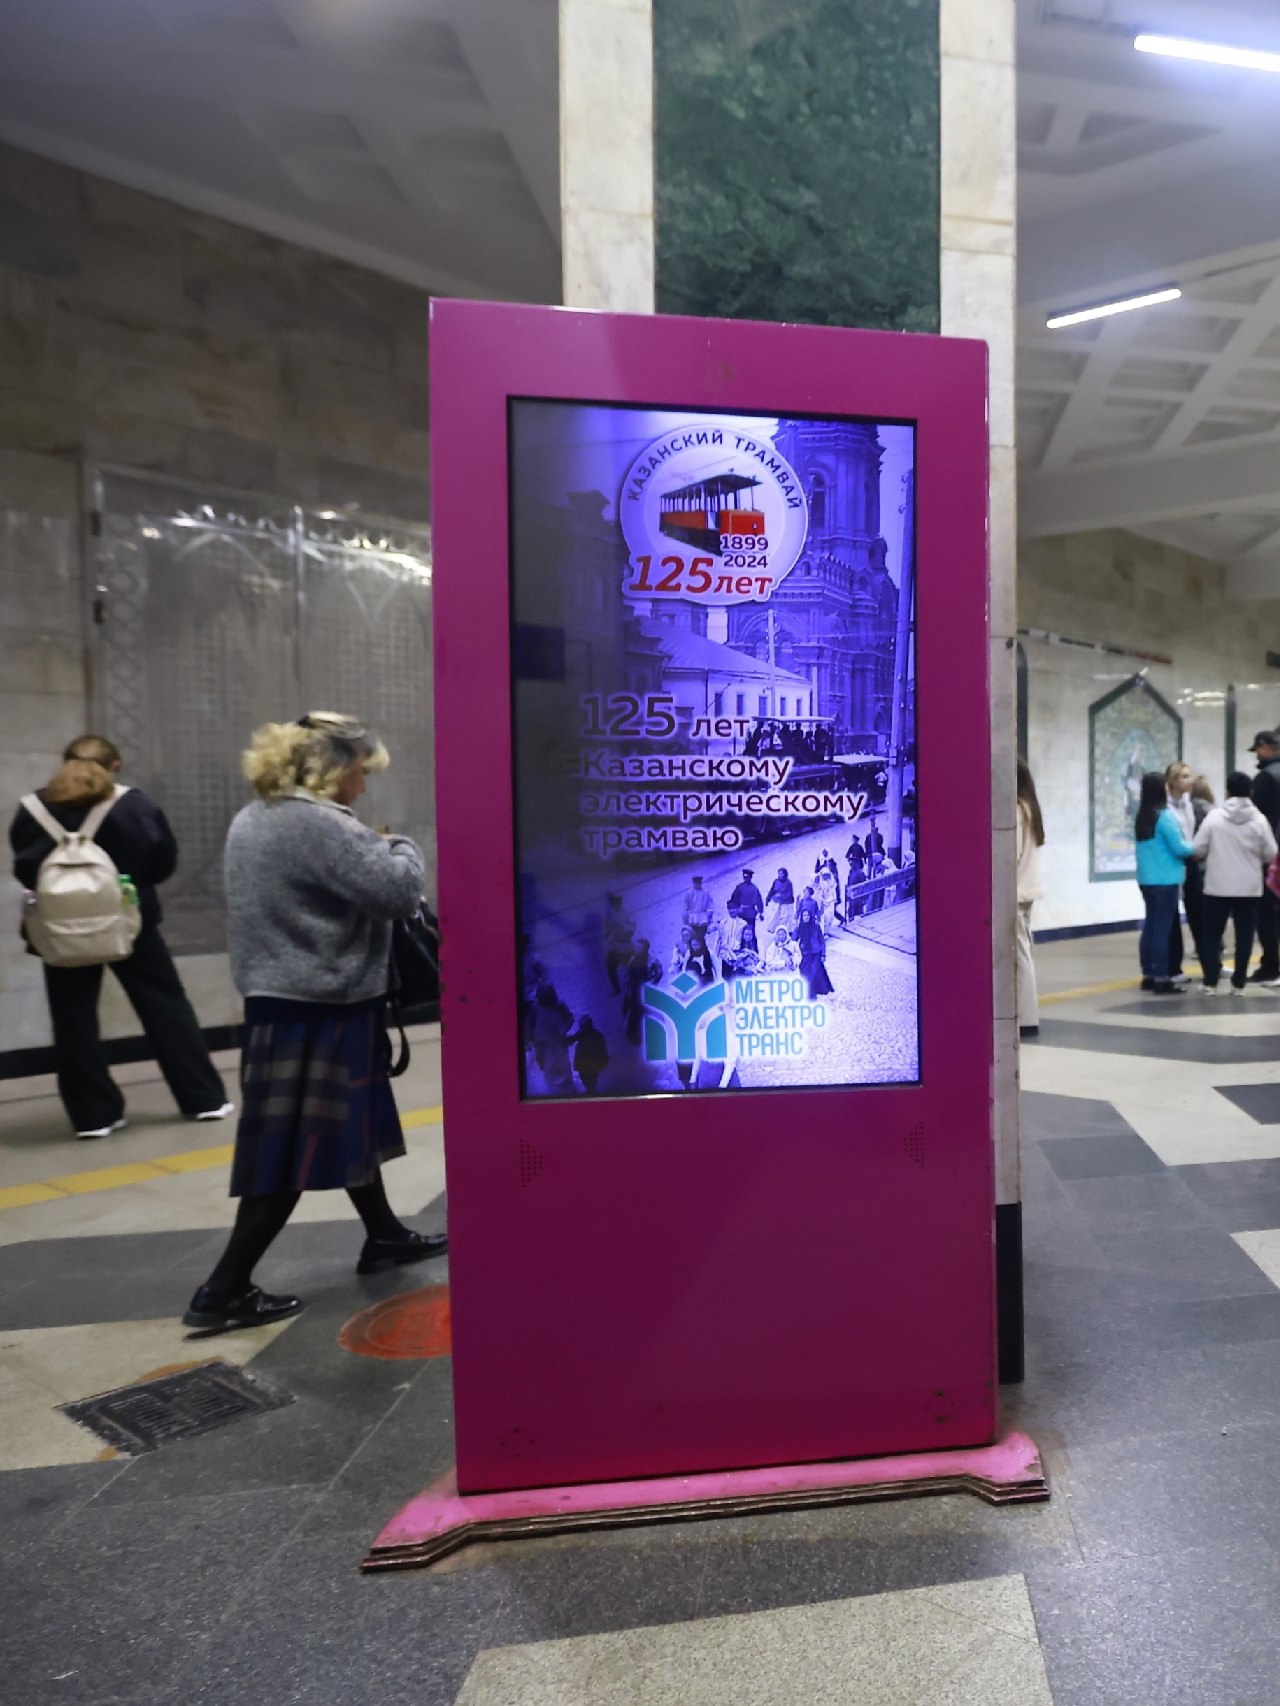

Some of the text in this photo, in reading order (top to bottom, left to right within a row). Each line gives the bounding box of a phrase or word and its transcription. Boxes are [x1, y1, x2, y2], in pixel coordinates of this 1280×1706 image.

[628, 430, 801, 509] КАЗАНСКИЙ ТРАМВАЙ
[721, 536, 769, 550] 1899
[723, 555, 768, 568] 2024
[583, 696, 750, 738] 125 лет
[584, 755, 790, 785] Казанскому
[582, 793, 865, 821] электрическому
[584, 829, 740, 851] трамваю
[735, 979, 803, 1003] МЕТРО
[736, 1005, 826, 1030] ЭЛЕКТРО
[735, 1032, 803, 1056] ТРАНС
